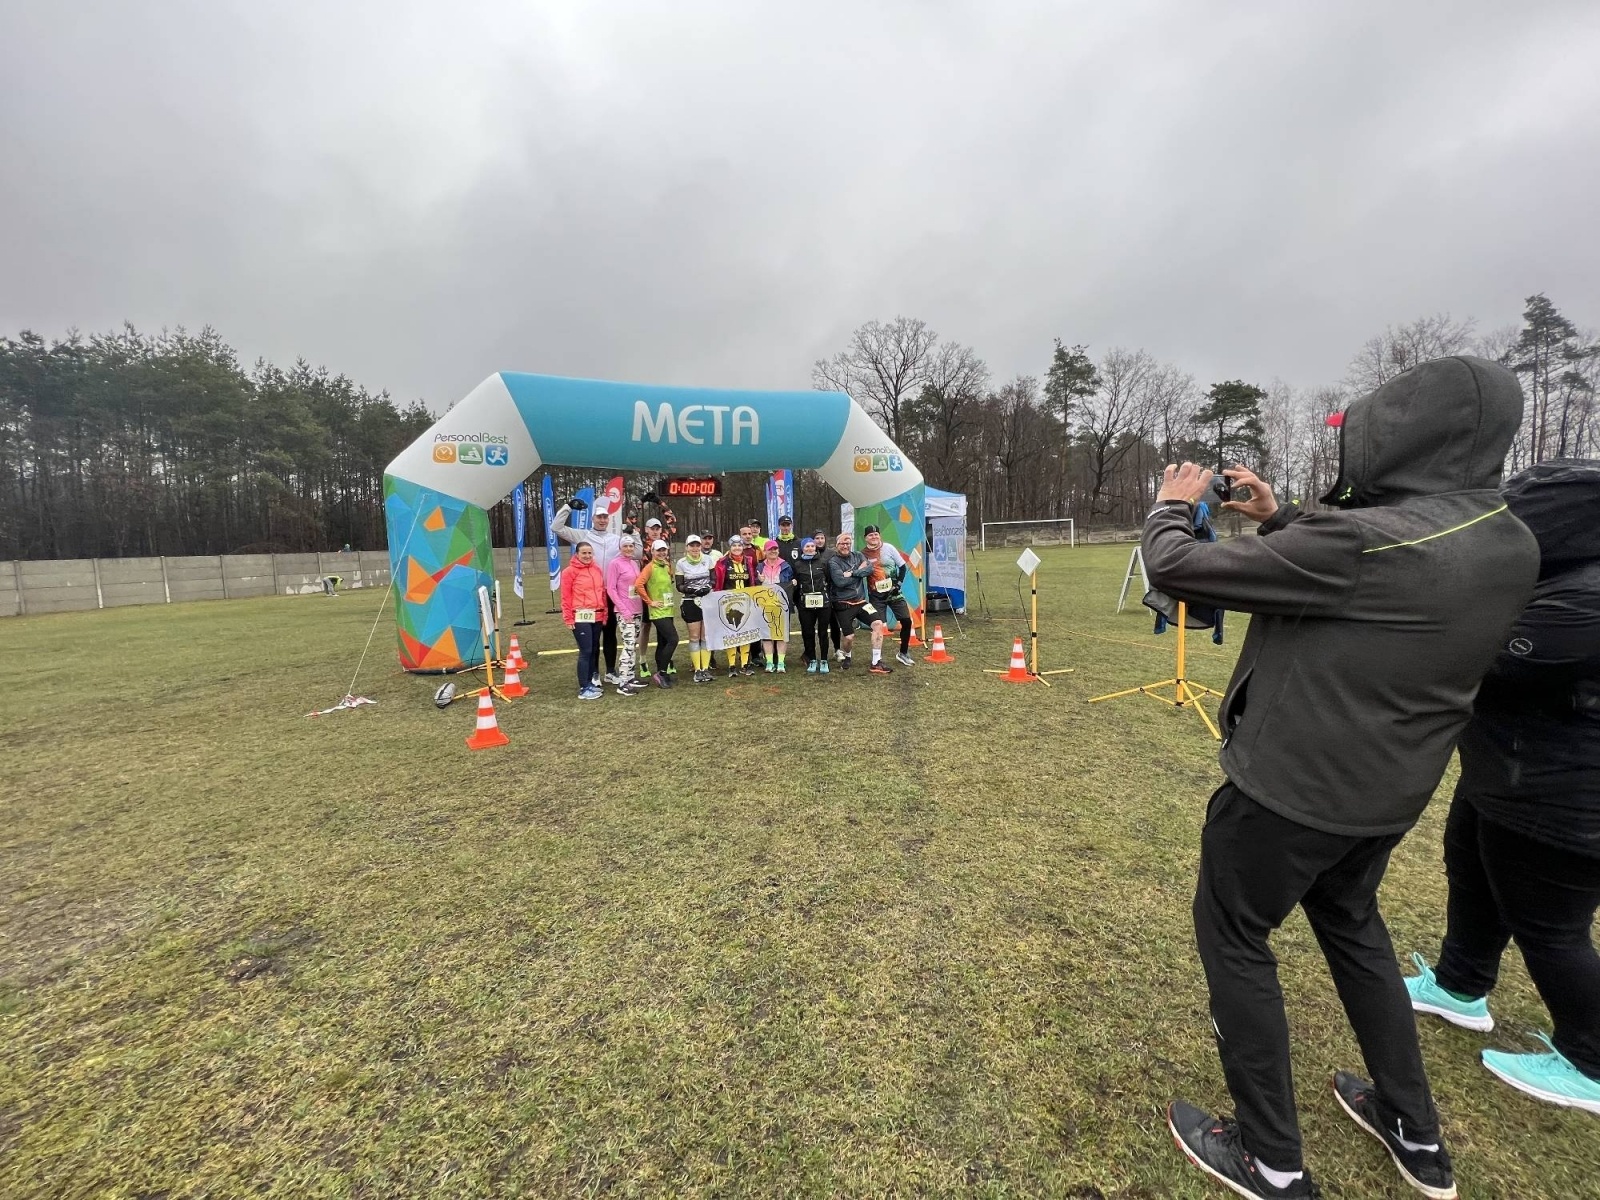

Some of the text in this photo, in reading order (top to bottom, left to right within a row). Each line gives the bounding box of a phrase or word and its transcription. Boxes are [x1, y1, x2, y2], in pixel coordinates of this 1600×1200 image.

[632, 400, 759, 445] META
[434, 432, 508, 444] PersonalBest
[669, 482, 715, 494] 0:00:00
[580, 612, 593, 620] 107
